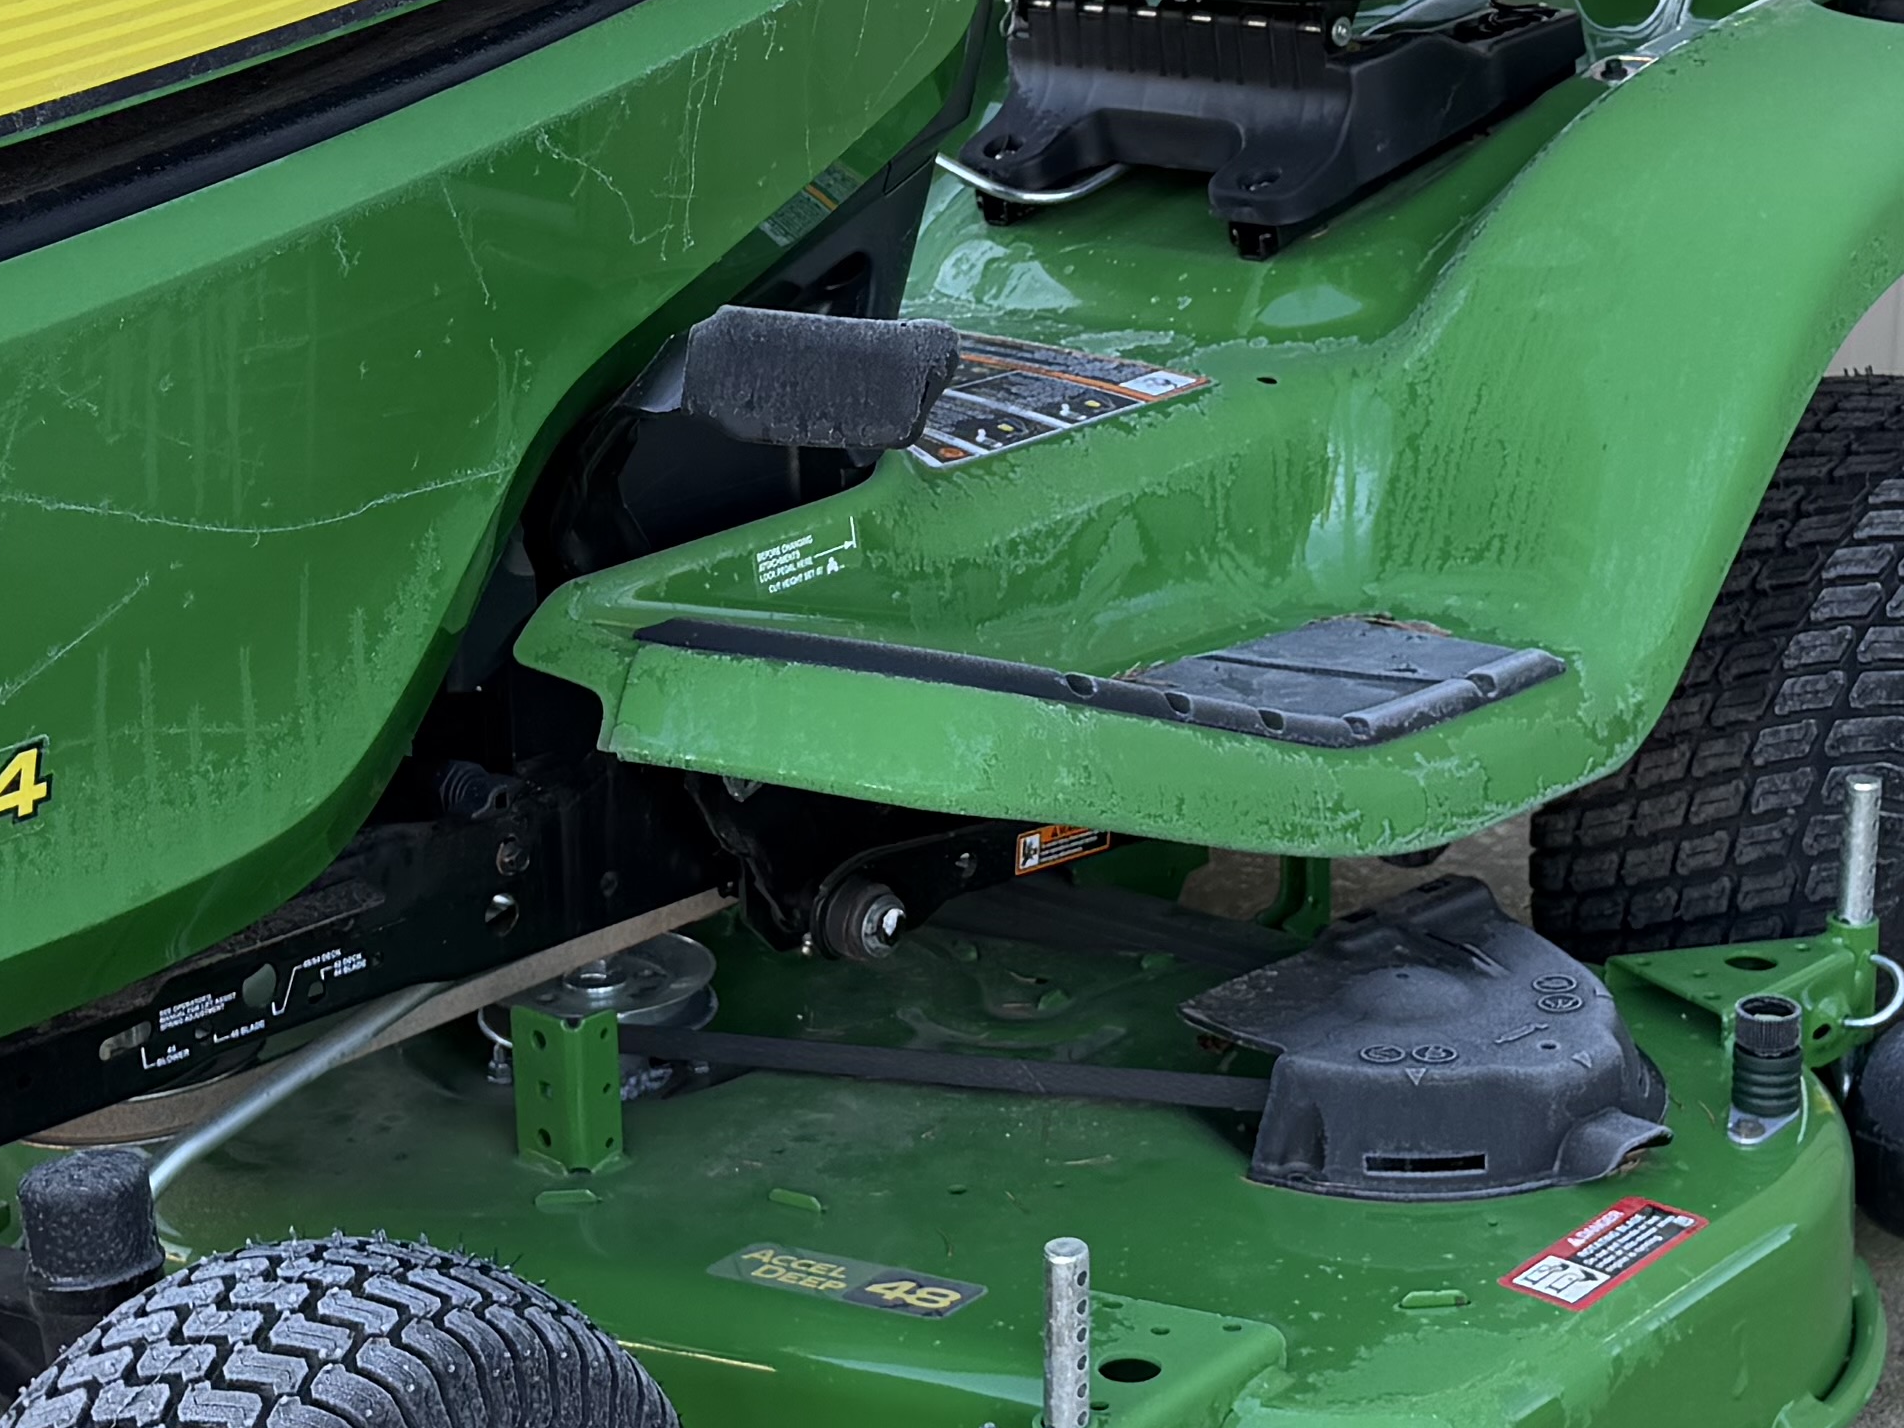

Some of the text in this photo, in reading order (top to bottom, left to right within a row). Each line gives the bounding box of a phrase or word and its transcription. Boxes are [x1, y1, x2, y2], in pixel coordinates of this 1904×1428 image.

[740, 1248, 847, 1279] ACCEL
[749, 1263, 847, 1291] DEEP
[863, 1279, 963, 1310] 48
